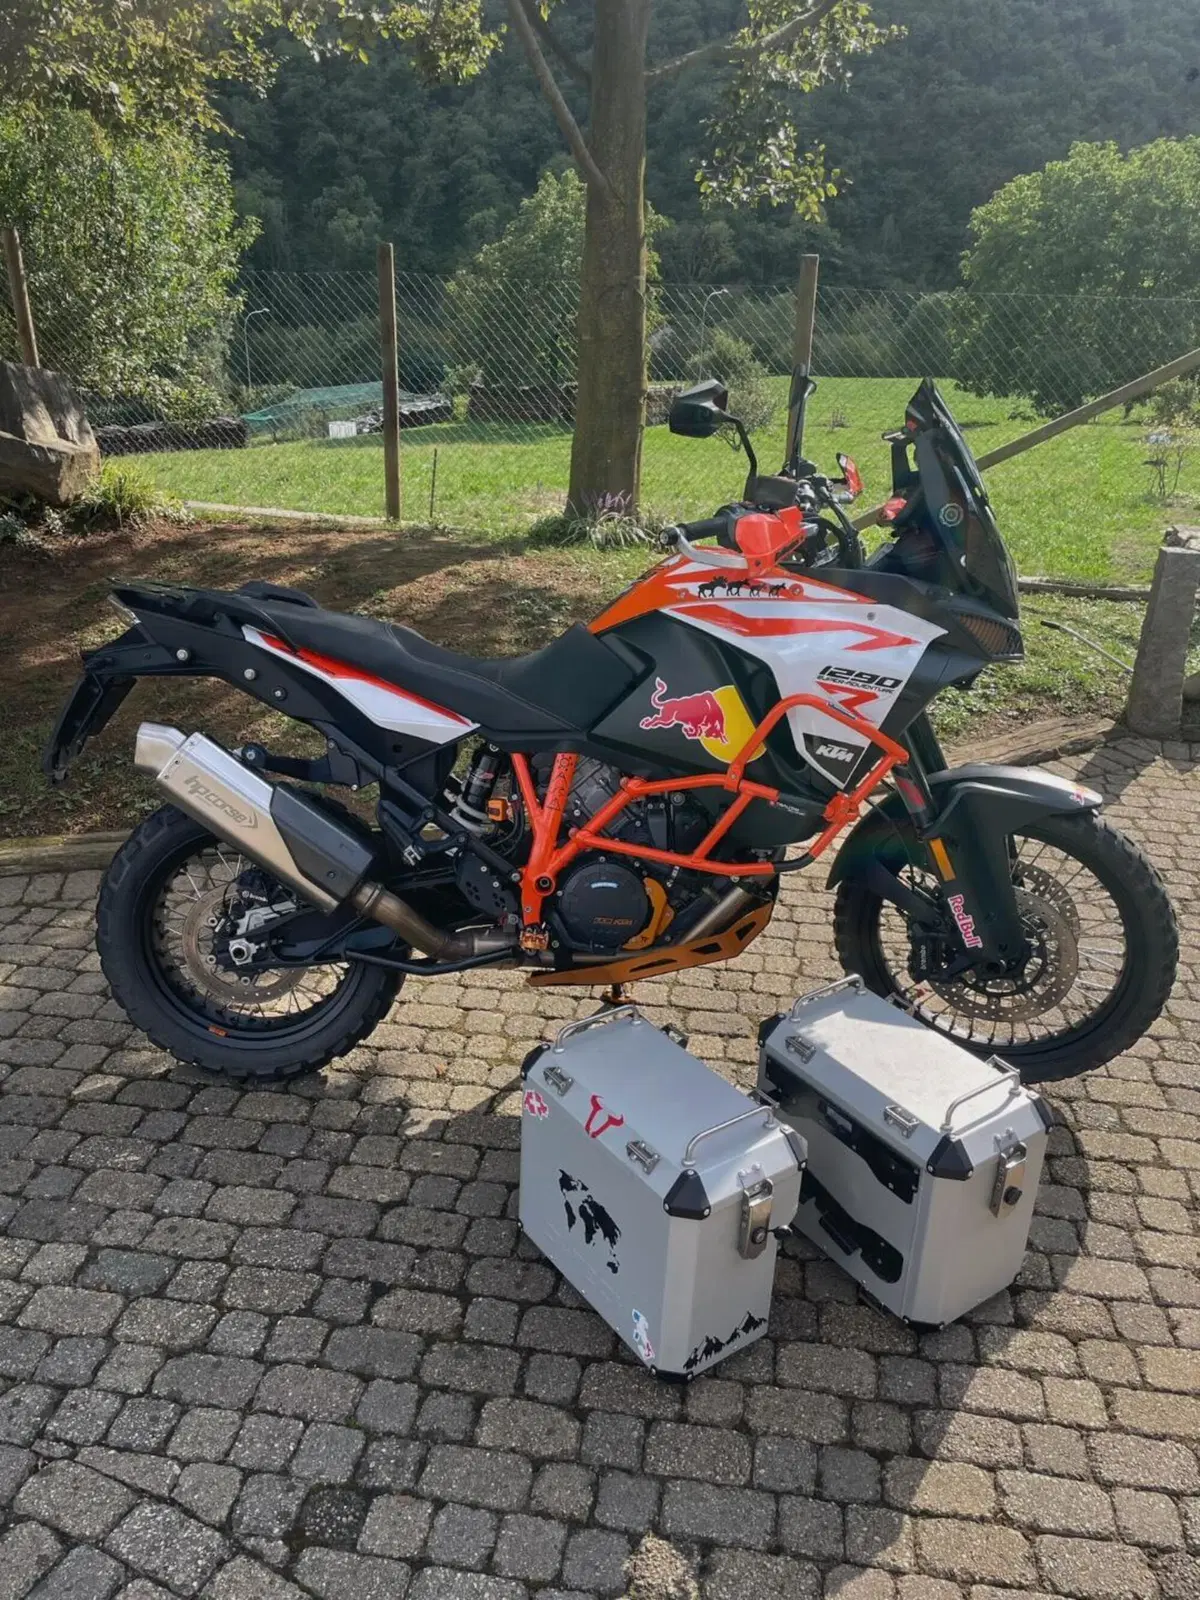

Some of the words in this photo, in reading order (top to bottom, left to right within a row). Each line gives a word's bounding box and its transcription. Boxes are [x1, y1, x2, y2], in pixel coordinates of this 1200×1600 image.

[819, 665, 904, 689] 1290
[815, 744, 854, 763] KTM
[183, 775, 248, 824] hpcorse
